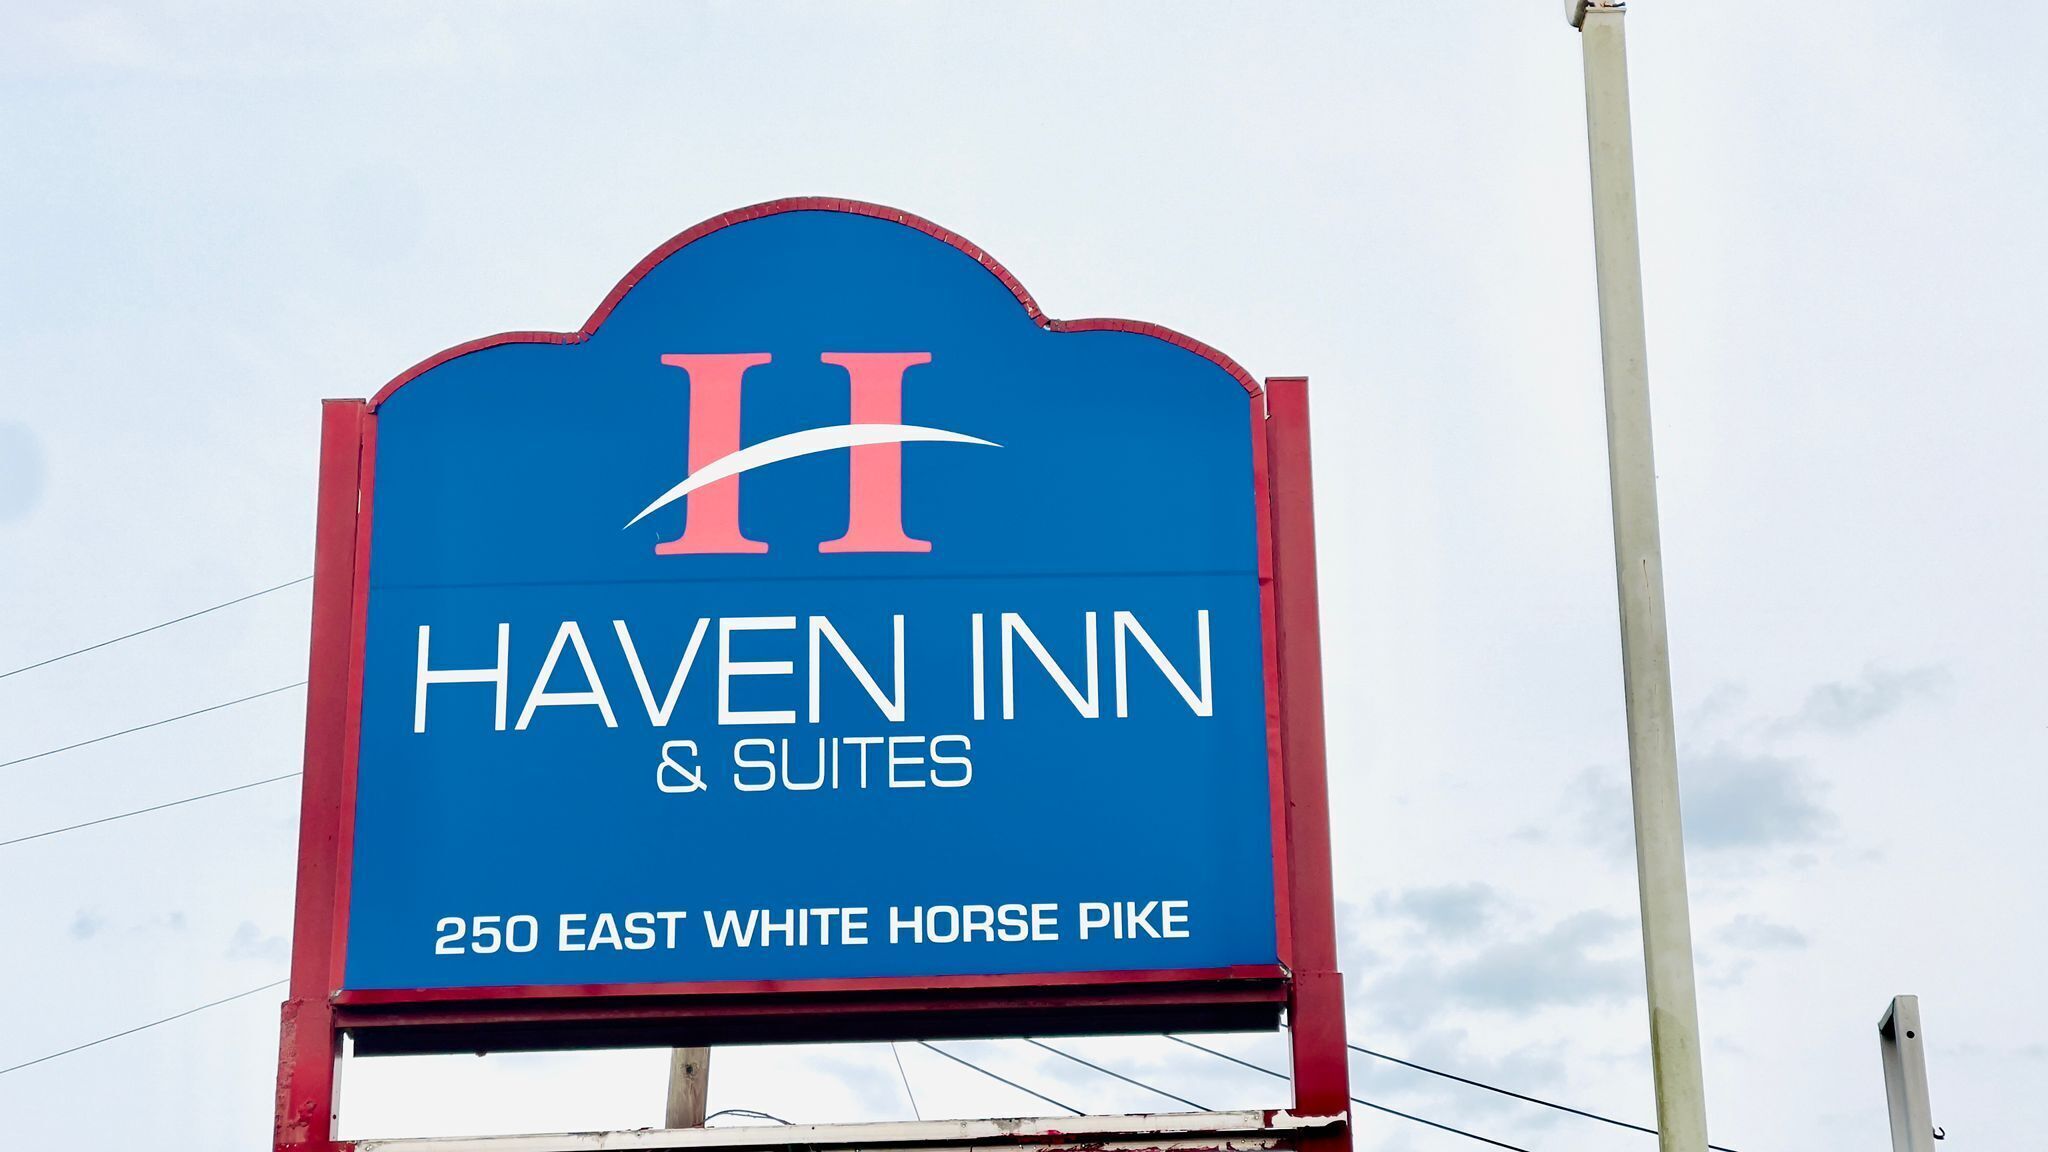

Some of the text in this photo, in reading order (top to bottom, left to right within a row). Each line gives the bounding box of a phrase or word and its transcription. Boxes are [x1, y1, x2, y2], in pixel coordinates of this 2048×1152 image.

[654, 351, 933, 556] H
[413, 609, 1213, 733] HAVEN INN
[656, 734, 973, 793] & SUITES
[435, 900, 1190, 955] 250 EAST WHITE HORSE PIKE
